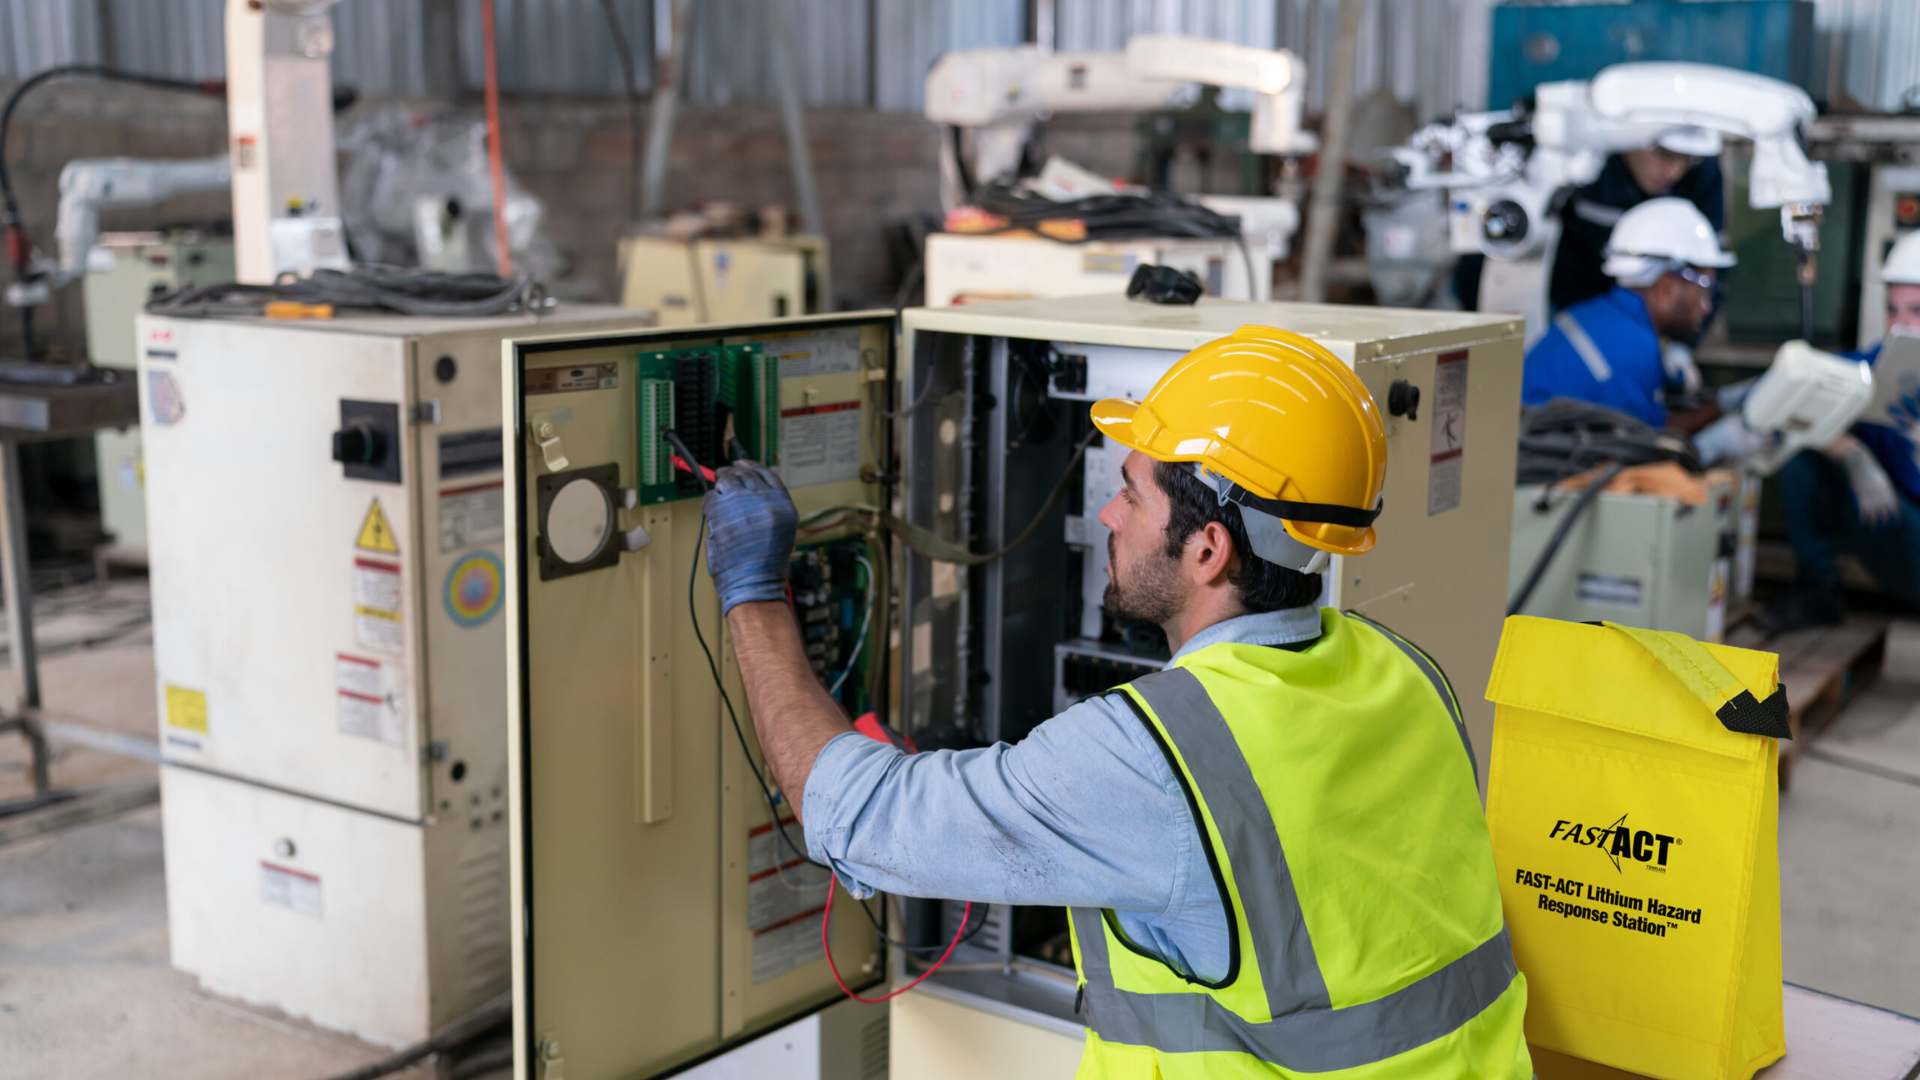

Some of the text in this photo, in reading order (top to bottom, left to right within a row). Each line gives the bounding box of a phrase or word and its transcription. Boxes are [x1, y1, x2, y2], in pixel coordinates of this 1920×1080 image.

[1515, 868, 1702, 924] FAST-ACT Lithium Hazard
[1537, 893, 1609, 923] Response
